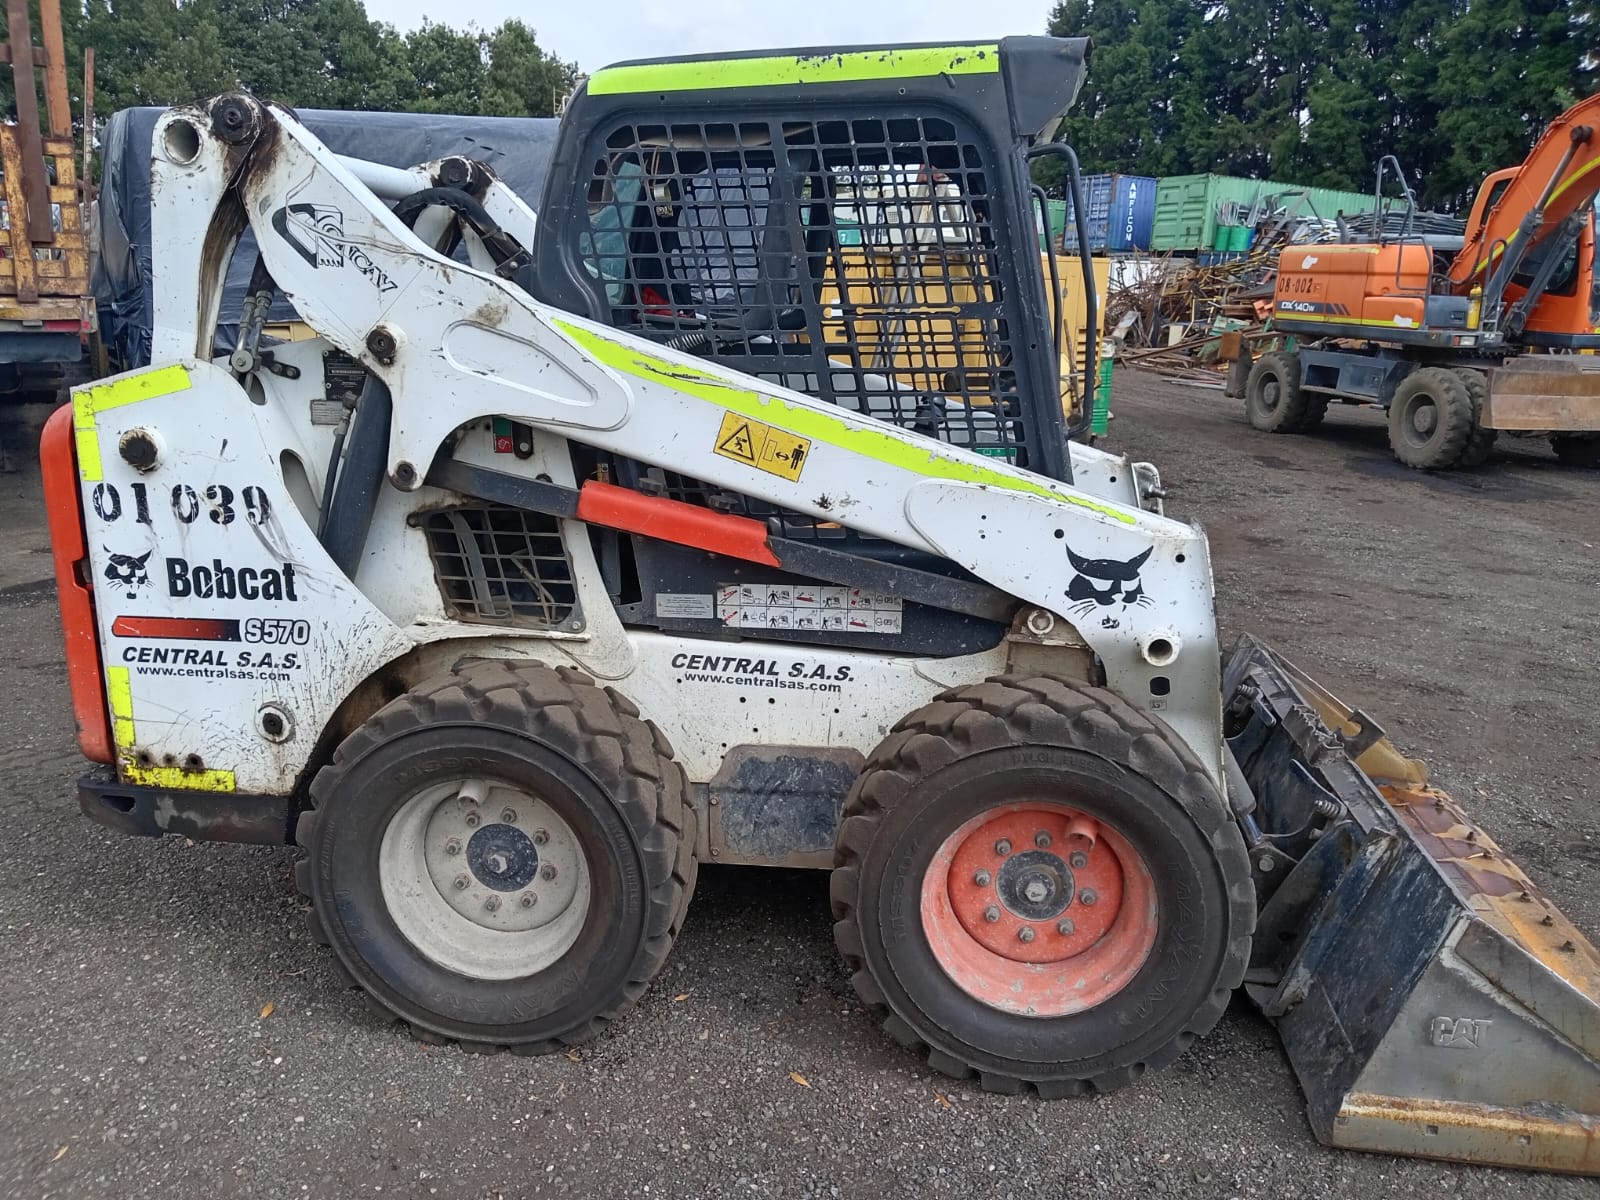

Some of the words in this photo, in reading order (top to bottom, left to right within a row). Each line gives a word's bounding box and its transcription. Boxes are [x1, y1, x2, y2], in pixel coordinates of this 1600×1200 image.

[92, 482, 152, 524] 01
[166, 558, 297, 601] Bobcat
[245, 618, 310, 645] S570
[122, 647, 228, 667] CENTRAL
[236, 652, 302, 670] S.A.S.
[671, 653, 780, 676] CENTRAL
[787, 661, 855, 682] S.A.S.
[137, 666, 290, 681] www.centralsas.com
[685, 672, 841, 692] www.centralsas.com
[1431, 1016, 1493, 1049] CAT
